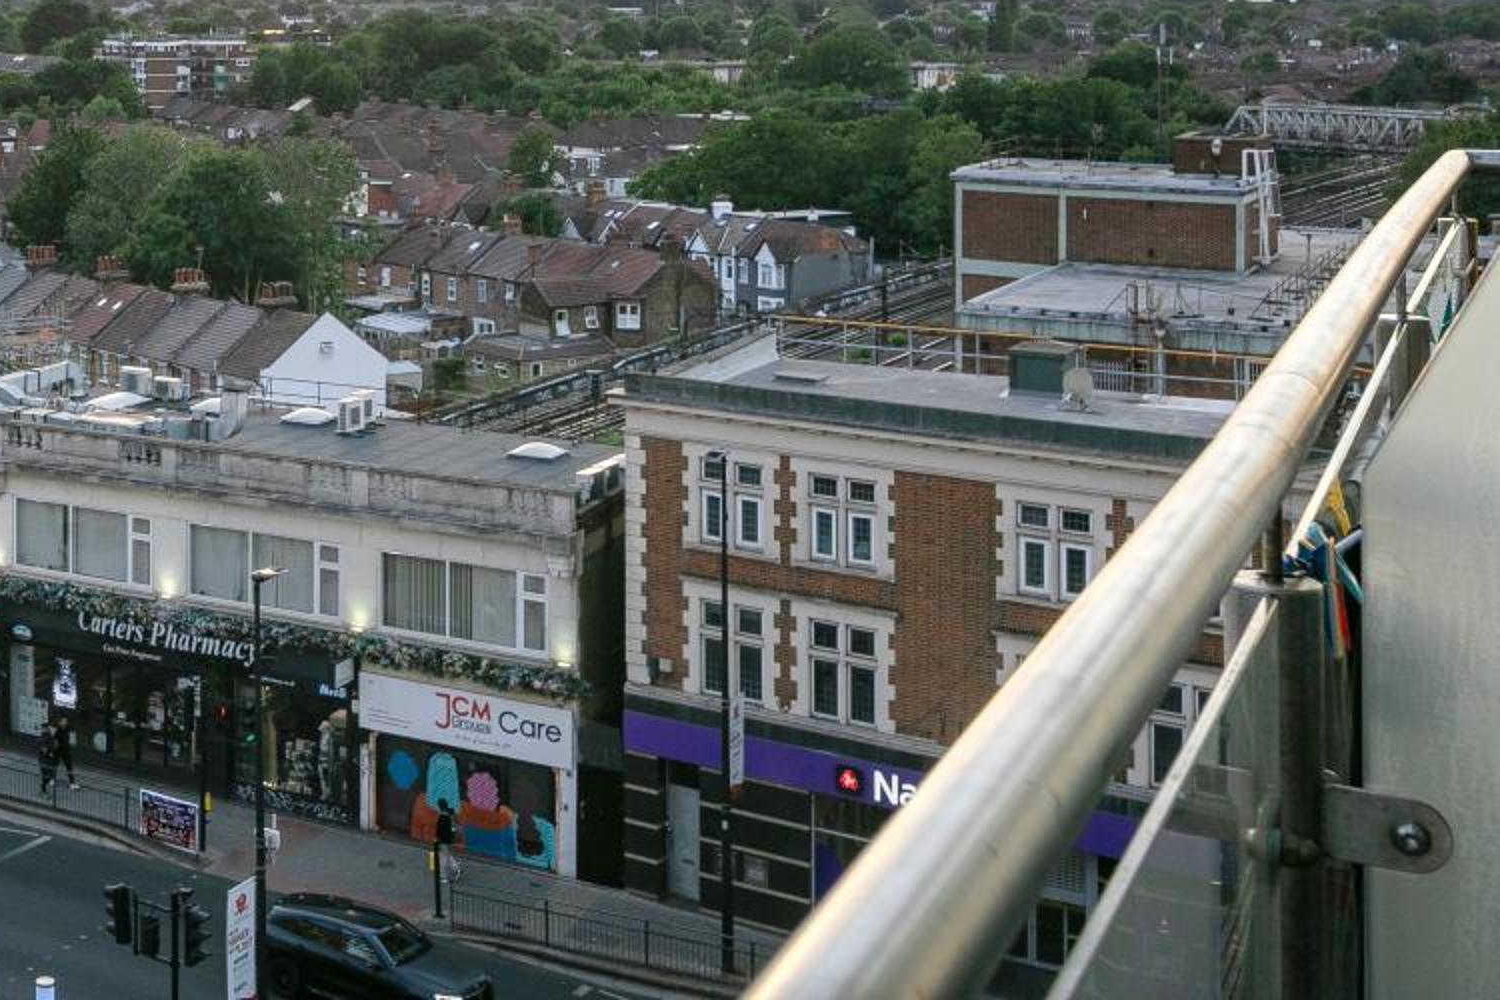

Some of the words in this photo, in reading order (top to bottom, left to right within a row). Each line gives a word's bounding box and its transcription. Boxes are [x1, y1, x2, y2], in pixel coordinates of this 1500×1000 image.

[150, 620, 257, 668] Pharmacy
[435, 692, 491, 729] JCM
[498, 711, 562, 743] Care
[873, 769, 916, 807] Na
